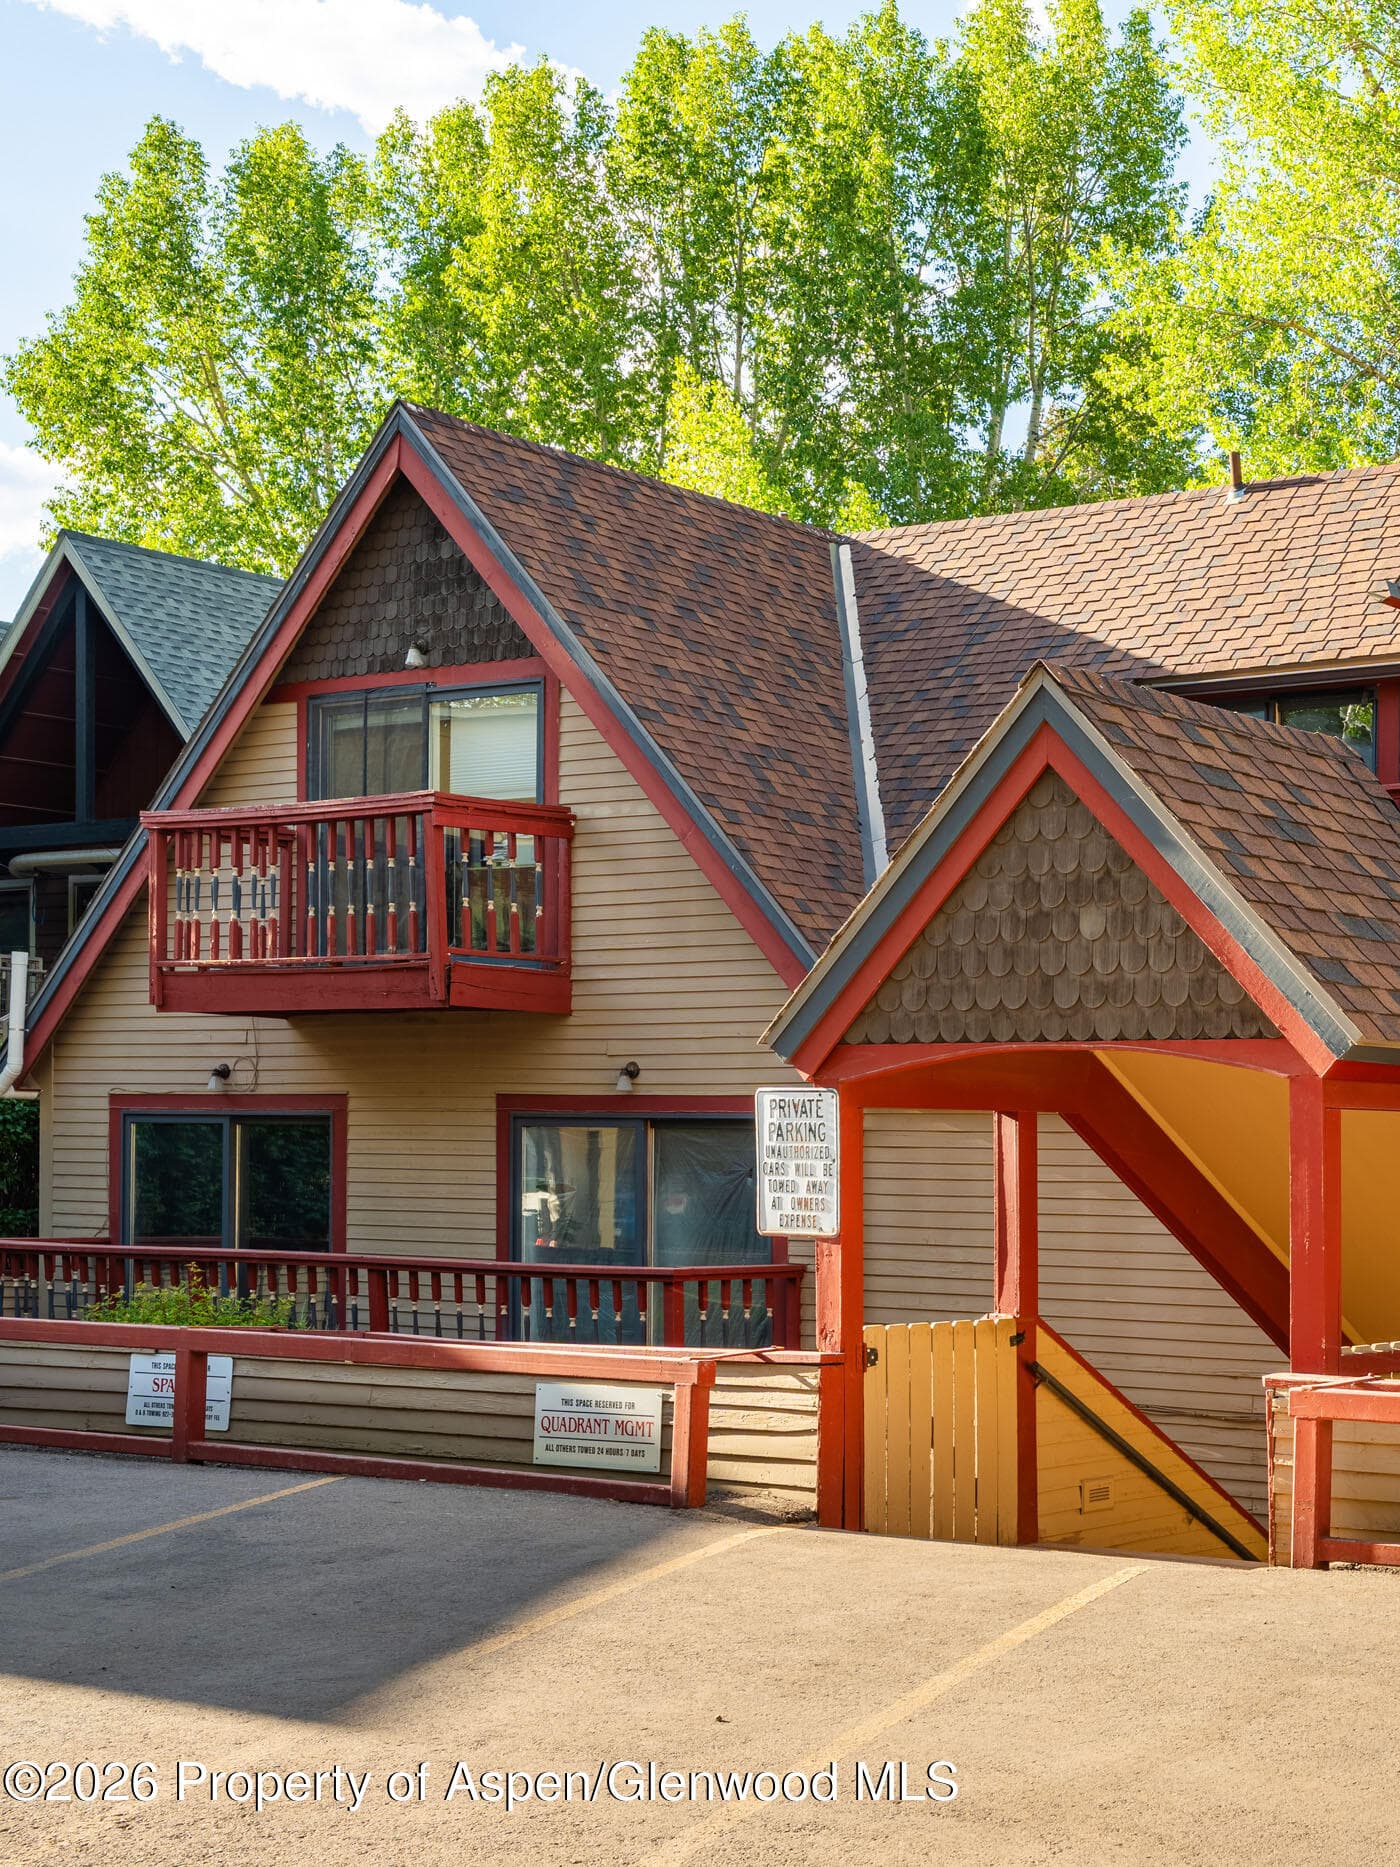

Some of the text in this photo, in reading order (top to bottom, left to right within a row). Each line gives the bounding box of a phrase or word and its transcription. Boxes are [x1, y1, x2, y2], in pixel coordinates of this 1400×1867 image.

[769, 1098, 824, 1119] PRIVATE
[768, 1122, 826, 1142] PARKING
[765, 1145, 830, 1160] UNAUTHORIZED
[763, 1162, 833, 1177] CARS WILL BE
[768, 1179, 829, 1194] TOWED AWAY
[771, 1197, 825, 1211] AT OWNERS
[779, 1214, 817, 1228] EXPENSE
[561, 1398, 635, 1409] THIS SPACE RESERVED FOR
[541, 1415, 654, 1437] QUADRANT MGMT
[545, 1443, 554, 1452] ALL
[556, 1444, 576, 1454] OTHERS
[577, 1446, 596, 1455] TOWED
[597, 1447, 604, 1455] 24
[631, 1449, 645, 1458] DAYS
